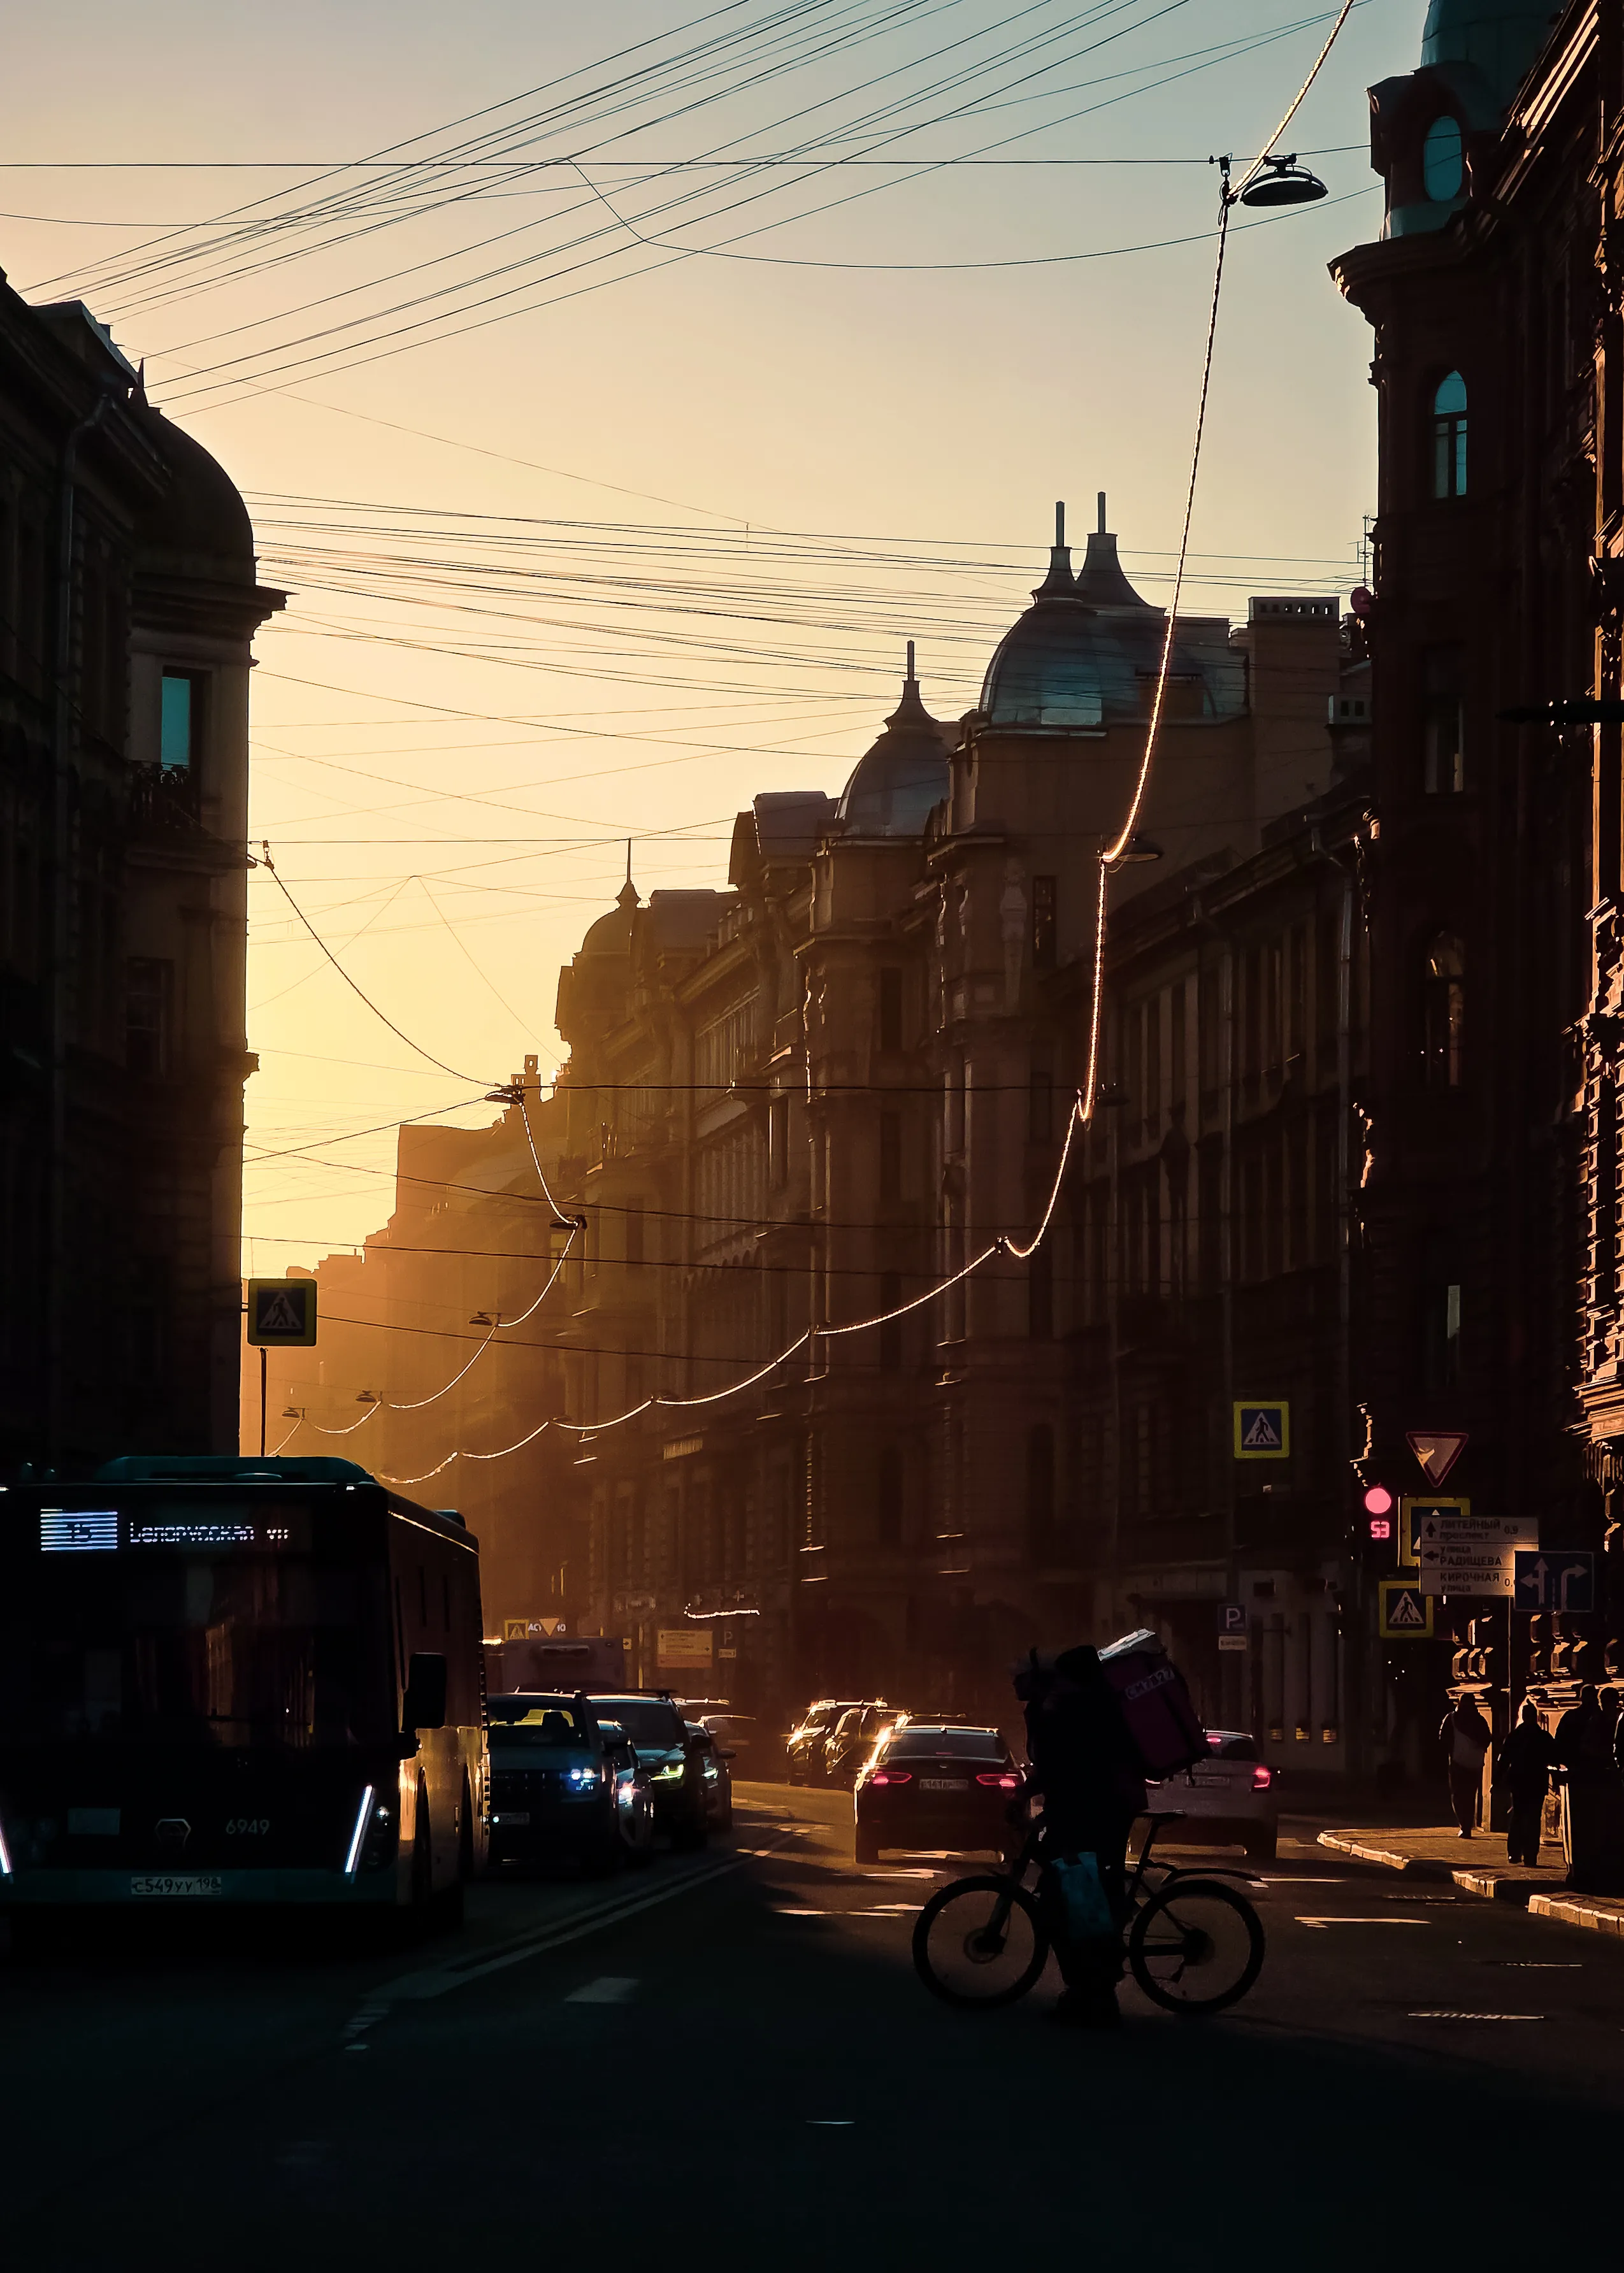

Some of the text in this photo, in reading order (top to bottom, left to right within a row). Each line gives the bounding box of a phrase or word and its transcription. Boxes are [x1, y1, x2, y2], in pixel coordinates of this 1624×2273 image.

[1370, 1521, 1390, 1538] 53
[1440, 1519, 1500, 1530] ЛИТЕЙНЫЙ
[1440, 1531, 1489, 1541] проспект
[1441, 1545, 1472, 1554] улица
[1440, 1556, 1502, 1567] РАДИЩЕВА
[1440, 1572, 1499, 1582] КИРОЧНАЯ
[1441, 1584, 1472, 1594] улица
[1226, 1608, 1241, 1630] P
[226, 1818, 270, 1835] 6949
